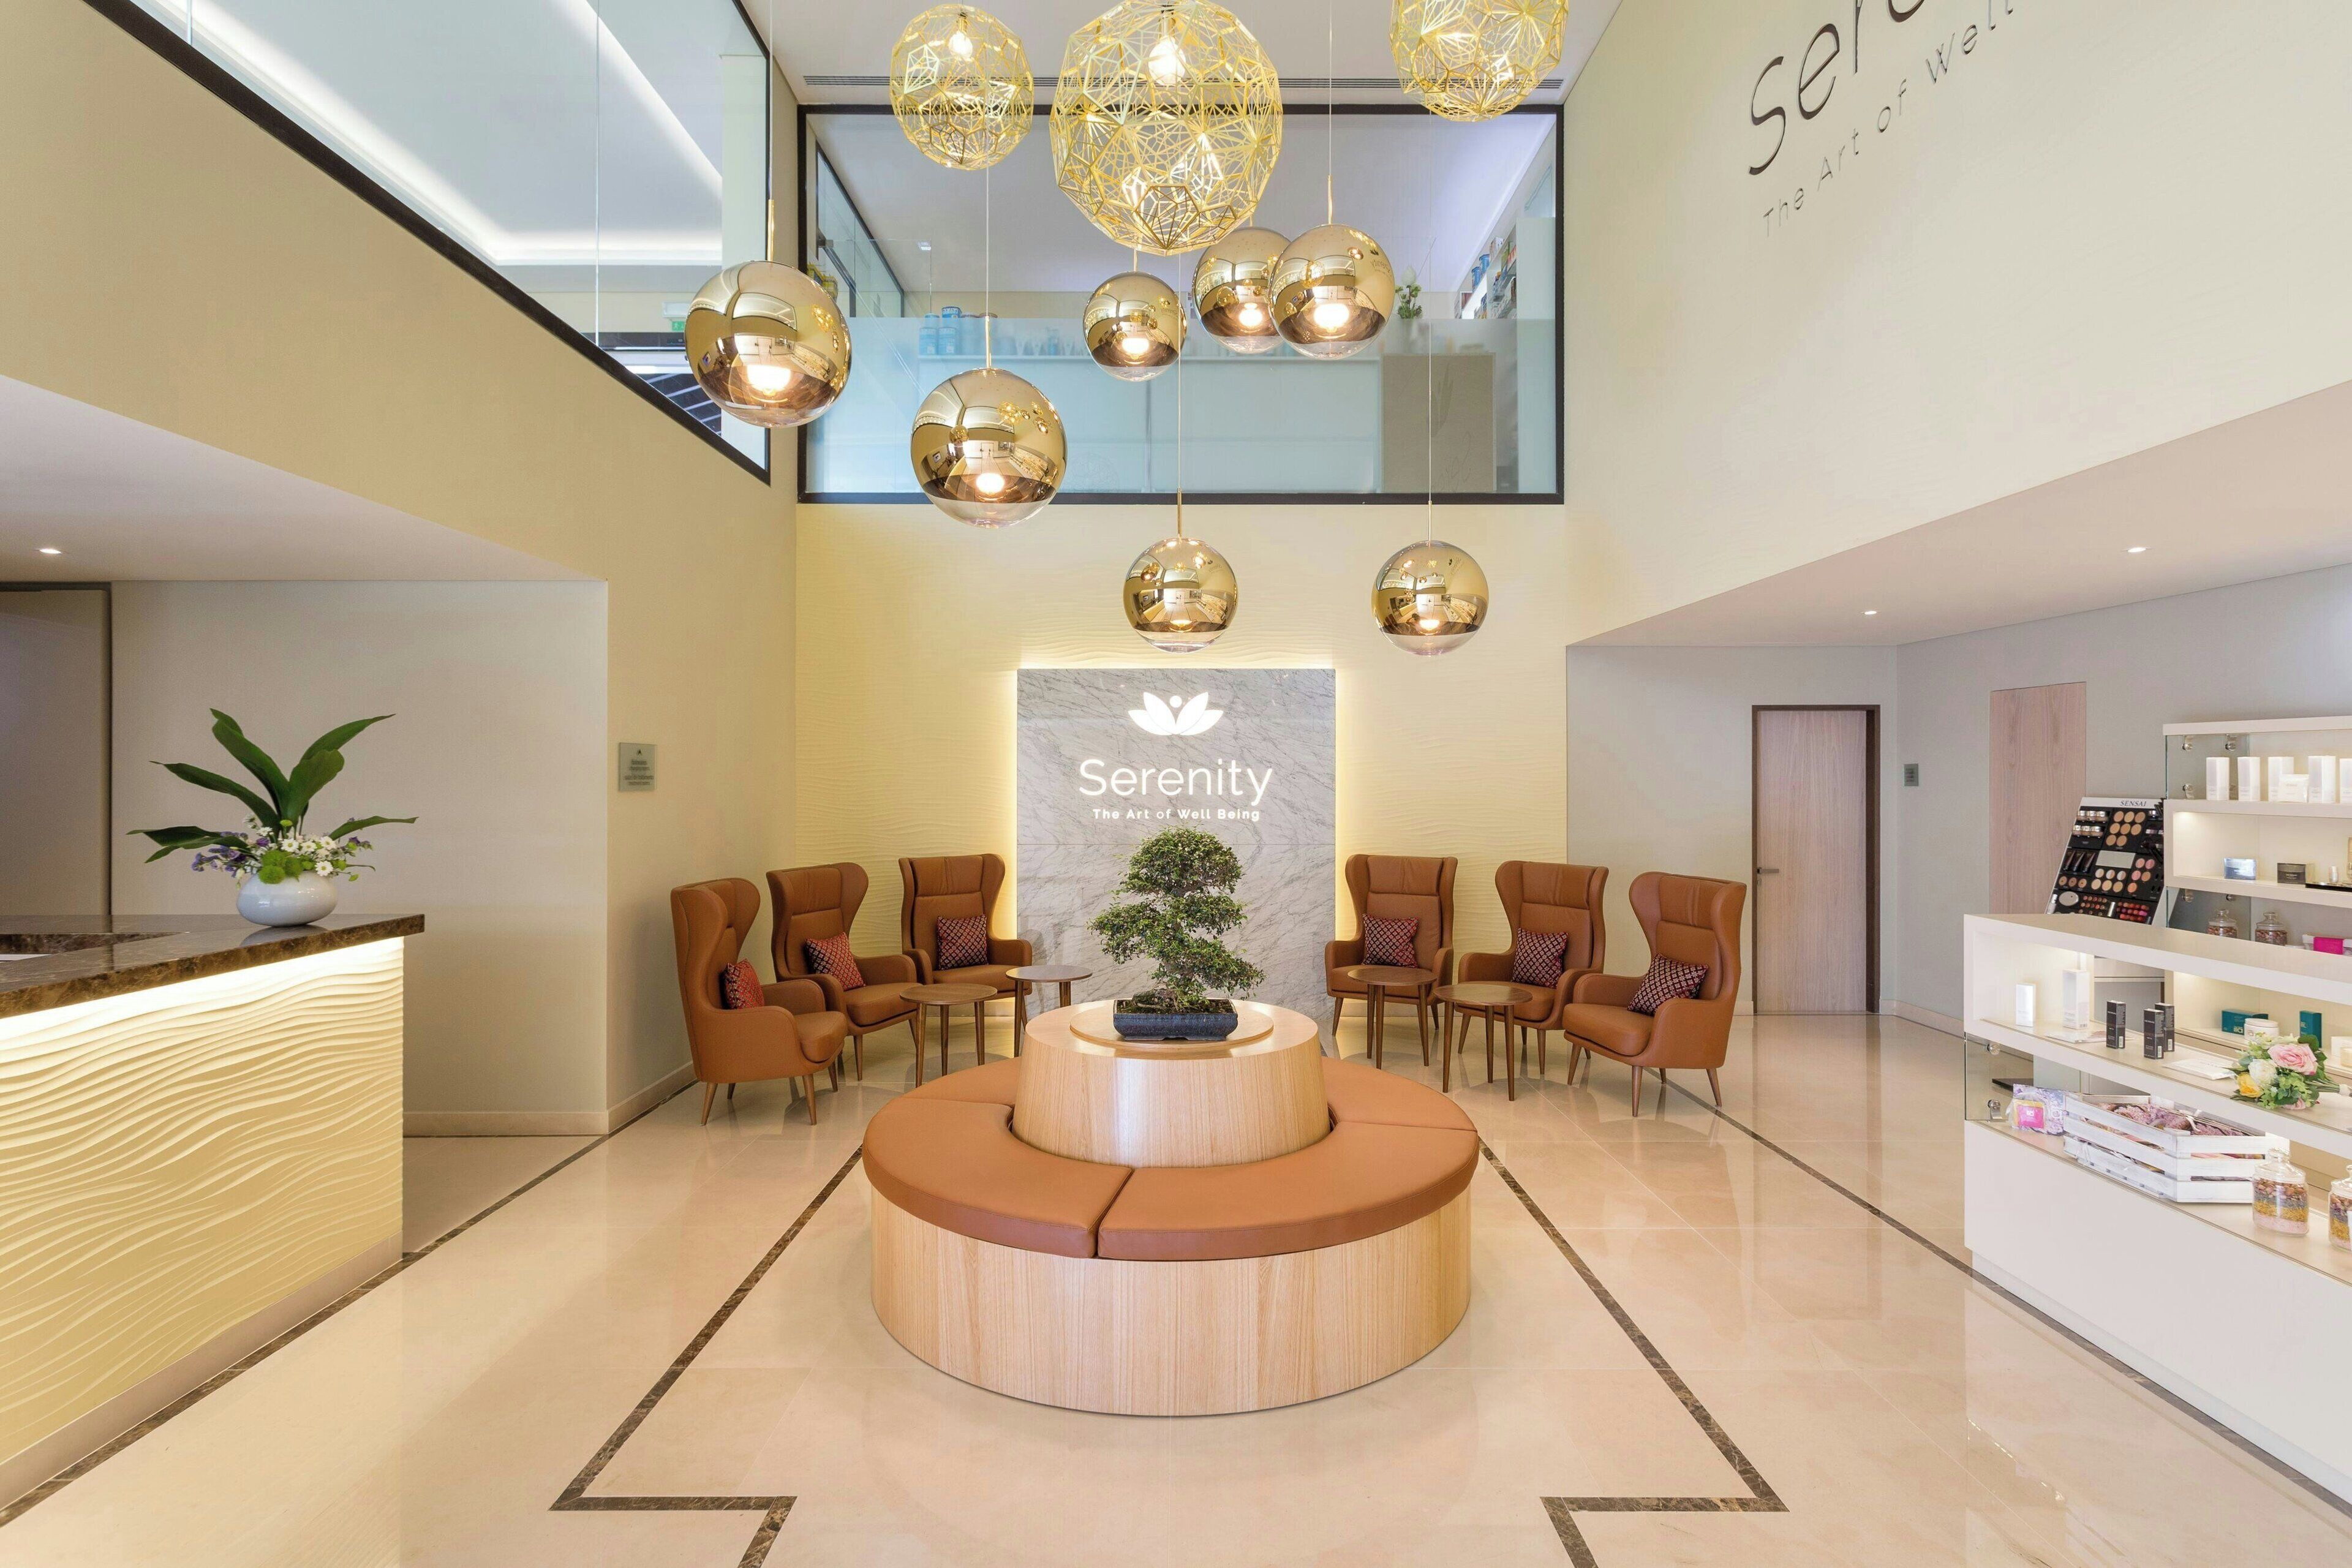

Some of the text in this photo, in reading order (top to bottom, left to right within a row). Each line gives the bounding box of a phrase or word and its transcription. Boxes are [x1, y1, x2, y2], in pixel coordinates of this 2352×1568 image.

[1748, 0, 1926, 175] Ser
[1763, 186, 1804, 238] The
[1817, 127, 1859, 192] Art
[1877, 78, 1907, 133] of
[1079, 758, 1273, 806] Serenity
[1092, 809, 1260, 821] The Art of Well Being
